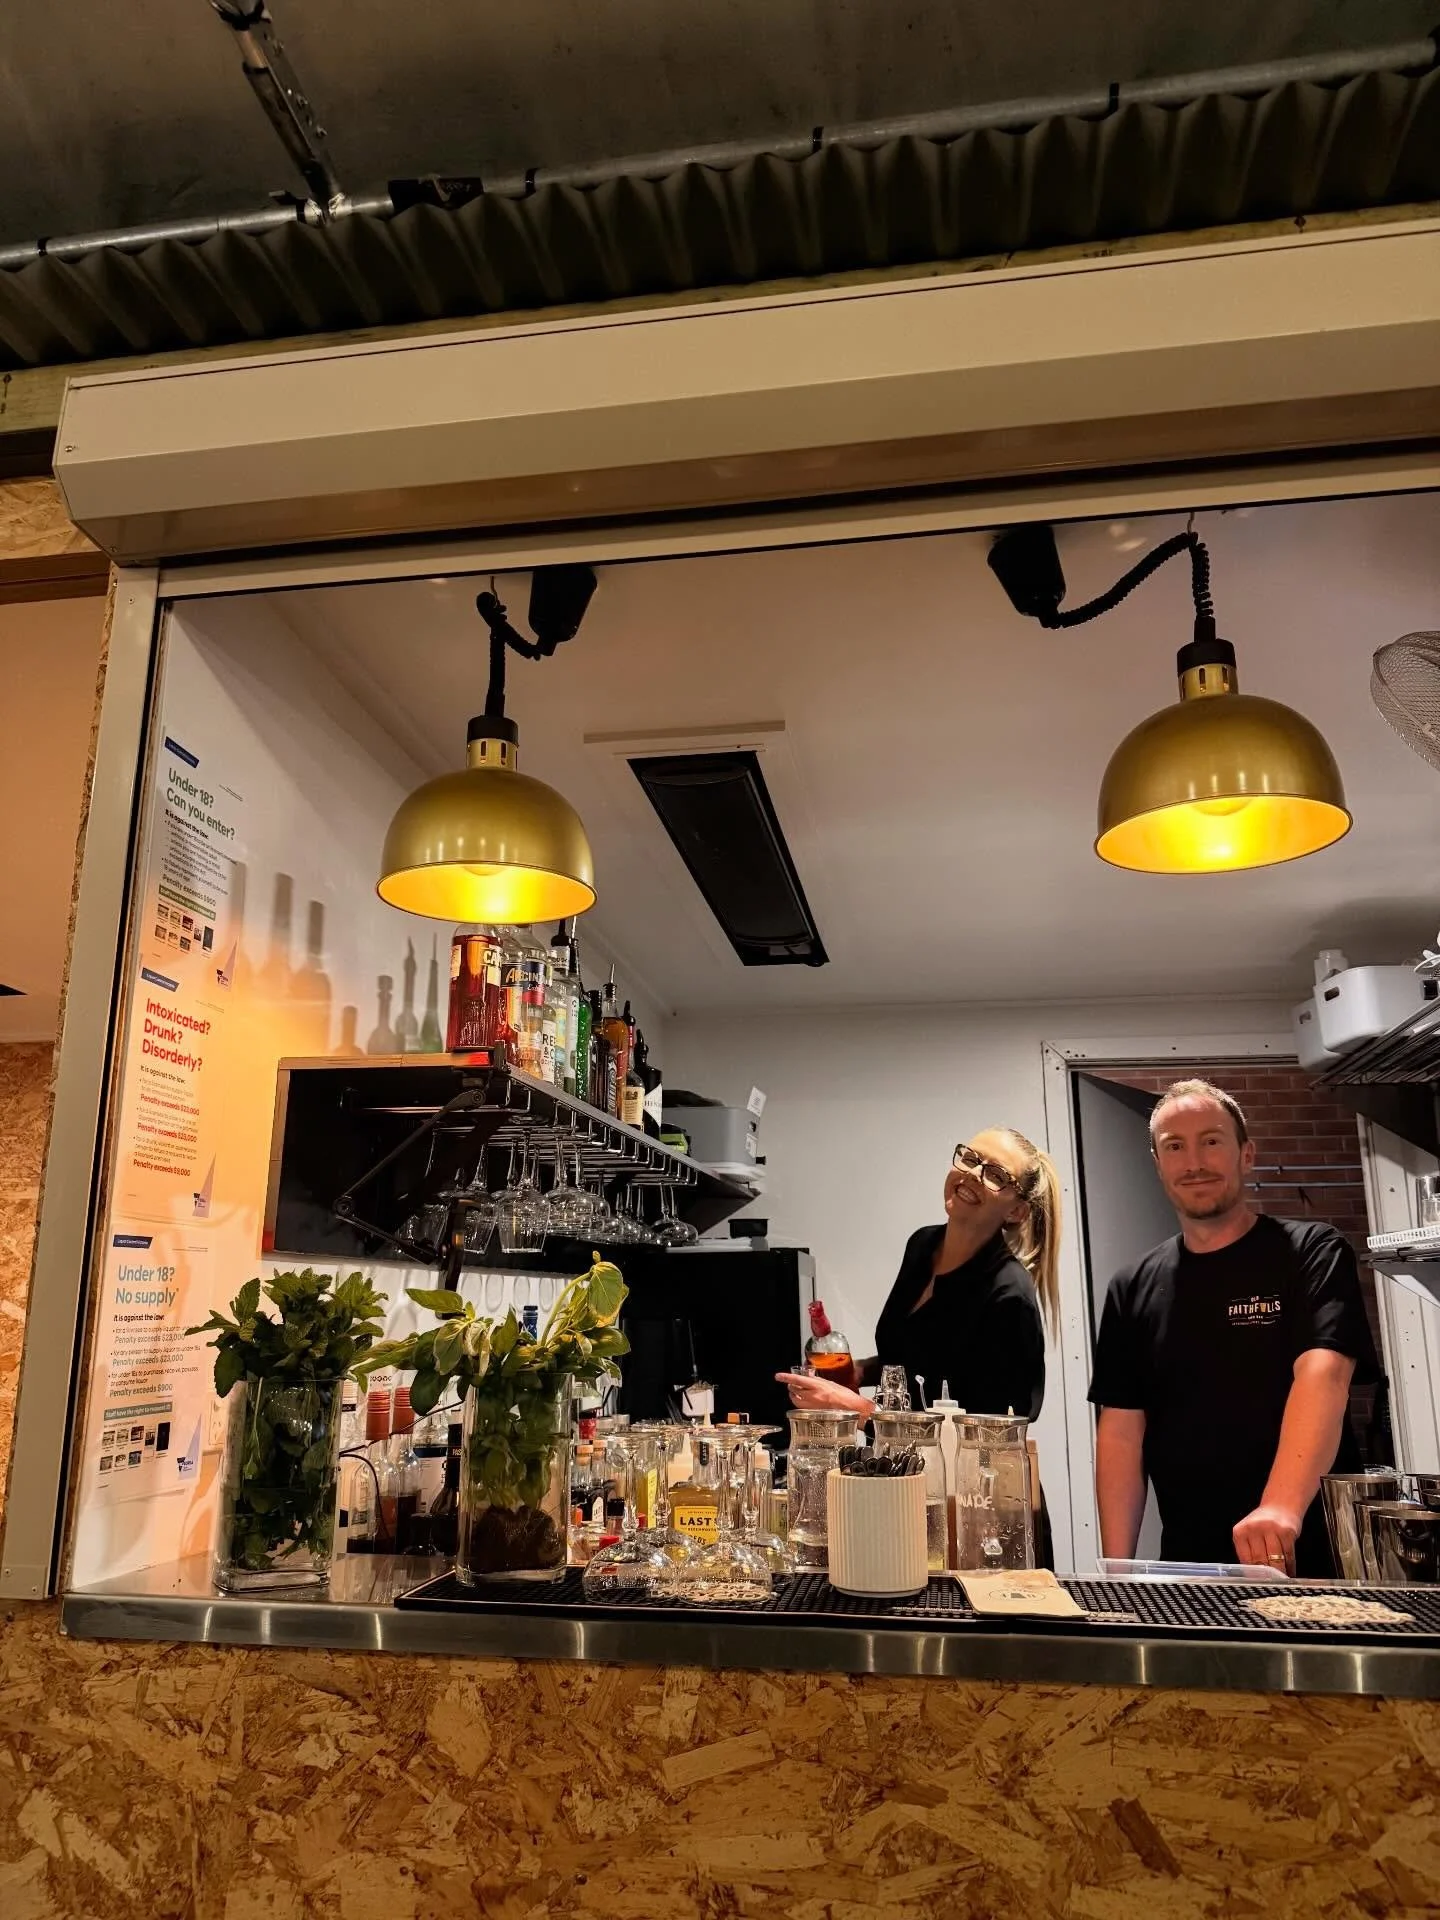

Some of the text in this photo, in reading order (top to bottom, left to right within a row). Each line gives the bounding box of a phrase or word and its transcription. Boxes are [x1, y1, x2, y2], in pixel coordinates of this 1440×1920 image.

[169, 768, 198, 797] Under
[200, 790, 214, 808] 18?
[167, 788, 235, 840] Can you enter?
[146, 998, 211, 1035] Intoxicated?
[144, 1018, 183, 1044] Drunk?
[142, 1039, 203, 1072] Disorderly?
[150, 1068, 168, 1078] against
[140, 1093, 160, 1107] Penalty
[137, 1122, 158, 1134] Penalty
[158, 1129, 177, 1139] exceeds
[133, 1159, 154, 1170] Penalty
[154, 1165, 173, 1174] exceeds
[118, 1264, 175, 1283] Under 18?
[116, 1287, 133, 1304] No
[124, 1313, 144, 1323] against
[144, 1313, 153, 1321] the
[115, 1335, 136, 1345] Penalty
[137, 1335, 161, 1343] exceeds
[112, 1357, 134, 1367] Penalty
[135, 1356, 159, 1365] exceeds
[109, 1386, 132, 1398] Penalty
[132, 1384, 157, 1395] exceeds
[680, 1516, 712, 1525] LAST
